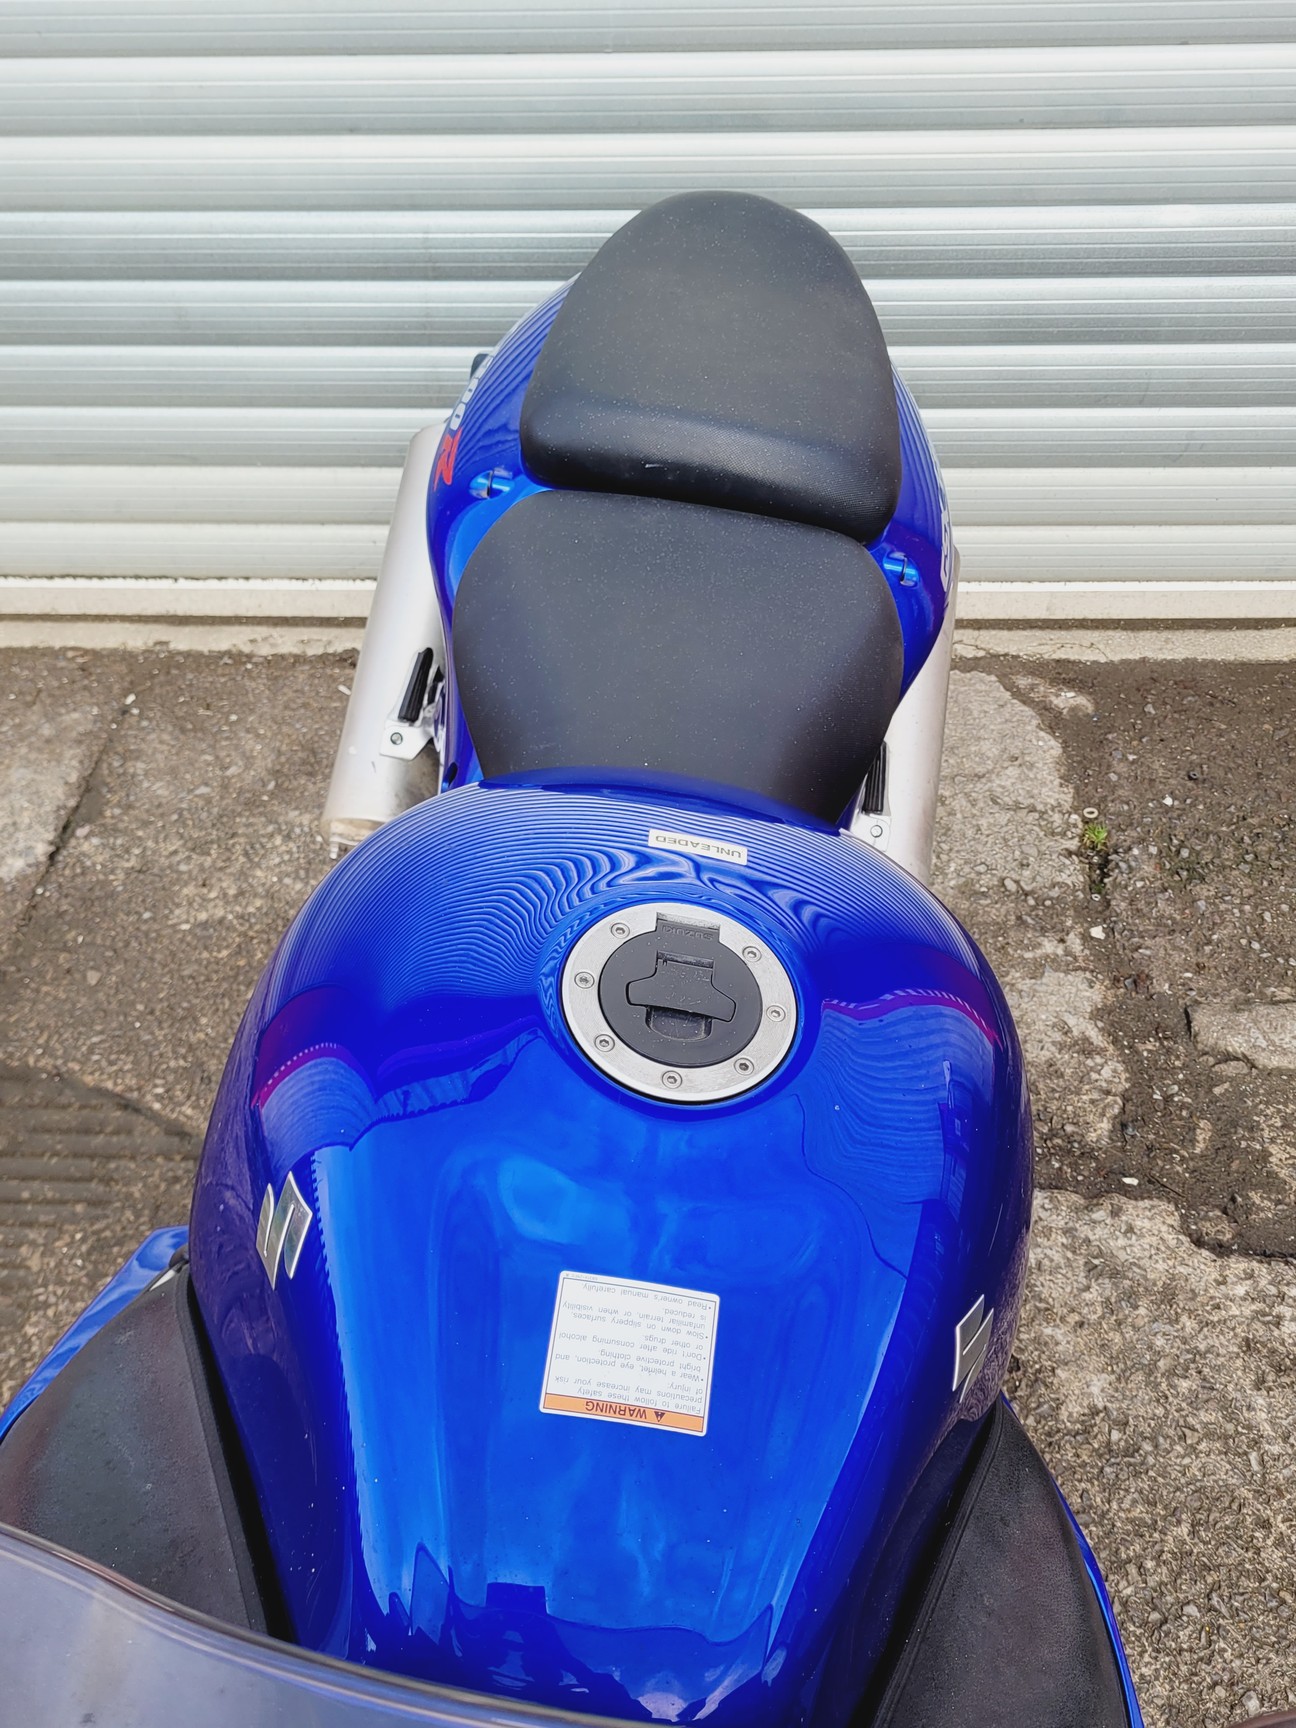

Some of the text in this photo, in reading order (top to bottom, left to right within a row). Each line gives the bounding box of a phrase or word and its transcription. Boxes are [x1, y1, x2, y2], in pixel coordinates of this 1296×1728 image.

[656, 835, 741, 858] UNLEADED
[662, 925, 713, 940] SUZUKI
[620, 1288, 648, 1299] manual
[653, 1294, 682, 1305] owner's
[687, 1300, 707, 1309] Read
[562, 1299, 593, 1312] visibility
[598, 1306, 618, 1316] when
[610, 1315, 641, 1328] slippery
[668, 1317, 705, 1329] unfamiliar
[661, 1325, 681, 1334] down
[686, 1330, 704, 1339] Slow
[558, 1331, 702, 1360] Don't ride after consuming alcohol
[671, 1339, 690, 1348] other
[554, 1353, 569, 1361] and
[635, 1353, 674, 1367] protective
[620, 1361, 634, 1370] eye
[679, 1361, 700, 1372] bright
[679, 1372, 699, 1381] Wear
[554, 1375, 702, 1404] precautions may increase your risk
[695, 1387, 703, 1395] of
[577, 1386, 701, 1413] Failure to follow these safety
[584, 1400, 647, 1418] WARNING
